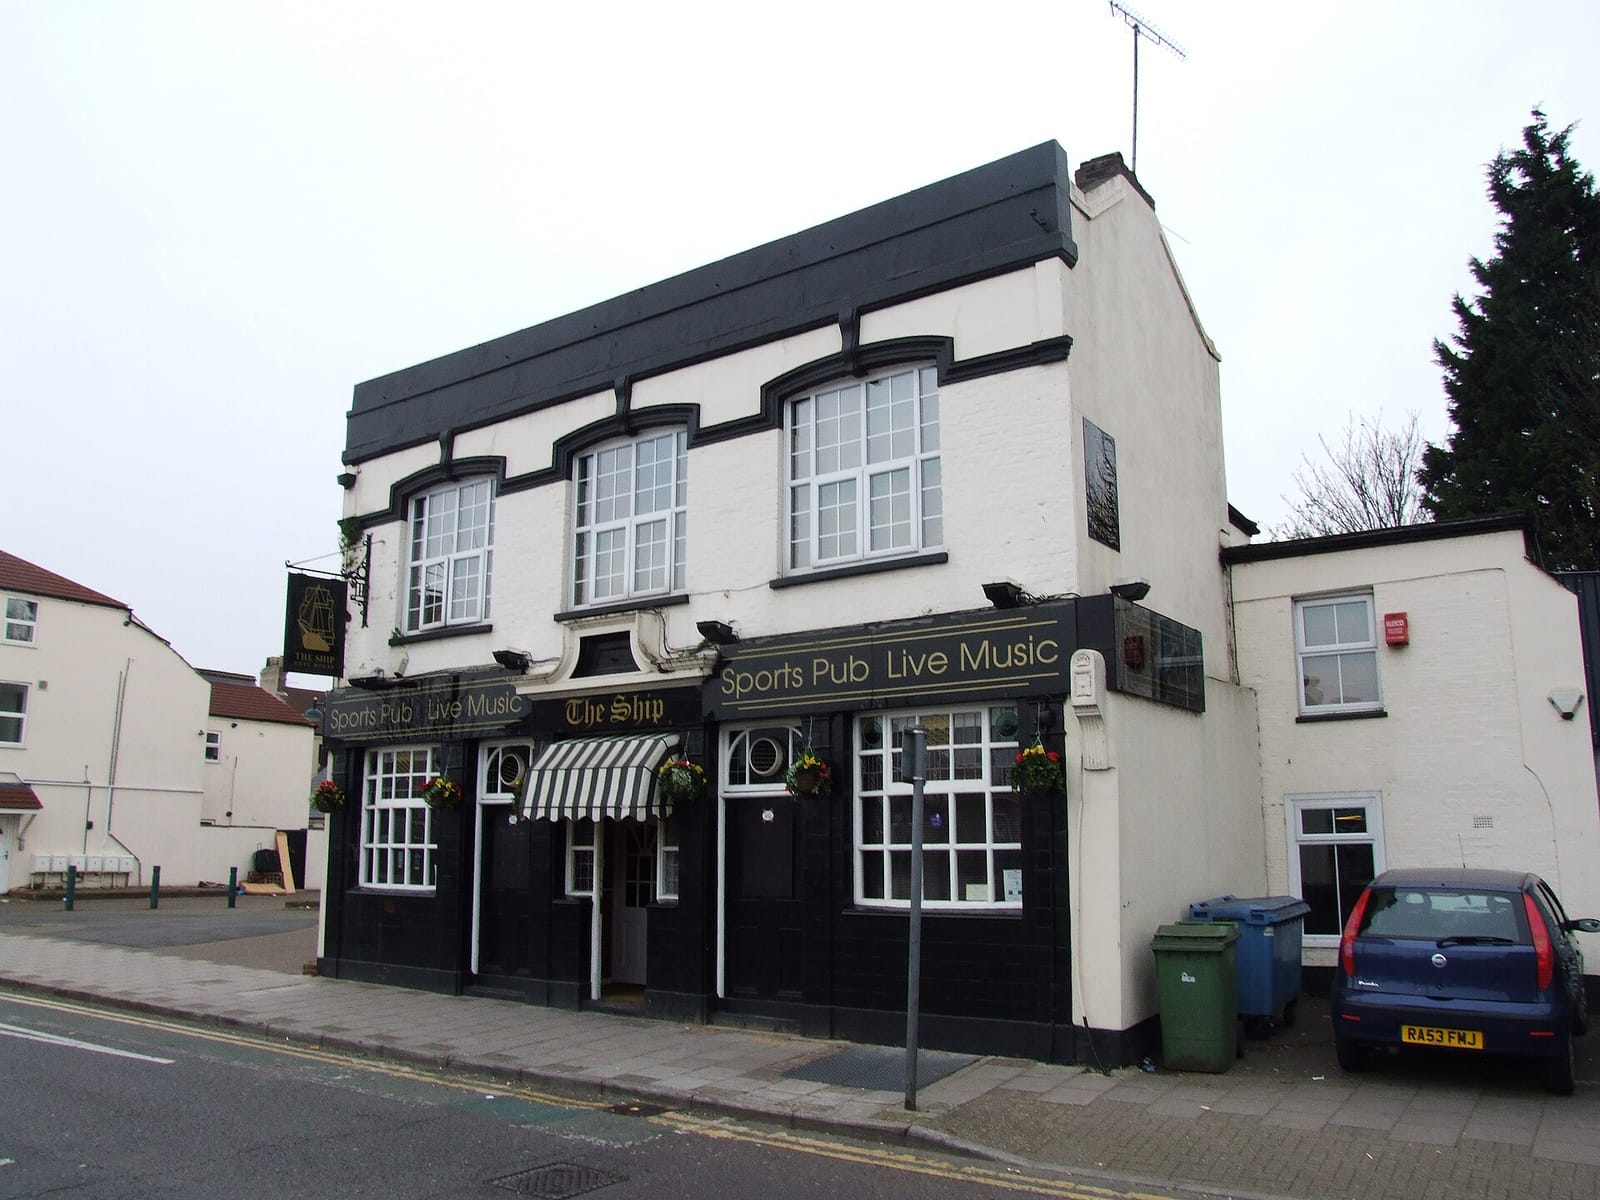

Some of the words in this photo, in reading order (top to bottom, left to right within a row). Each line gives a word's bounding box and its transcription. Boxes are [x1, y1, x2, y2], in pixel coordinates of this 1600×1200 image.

[721, 662, 803, 699] Sports
[813, 655, 870, 686] Pub
[887, 648, 949, 678] Live
[960, 634, 1059, 672] Music
[330, 706, 377, 732] Sports
[380, 702, 413, 725] Pub
[427, 698, 462, 720] Live
[467, 691, 522, 717] Music
[565, 698, 606, 728] The
[610, 694, 664, 725] Ship
[1407, 1027, 1444, 1043] RA53
[1447, 1030, 1476, 1046] FMJ
